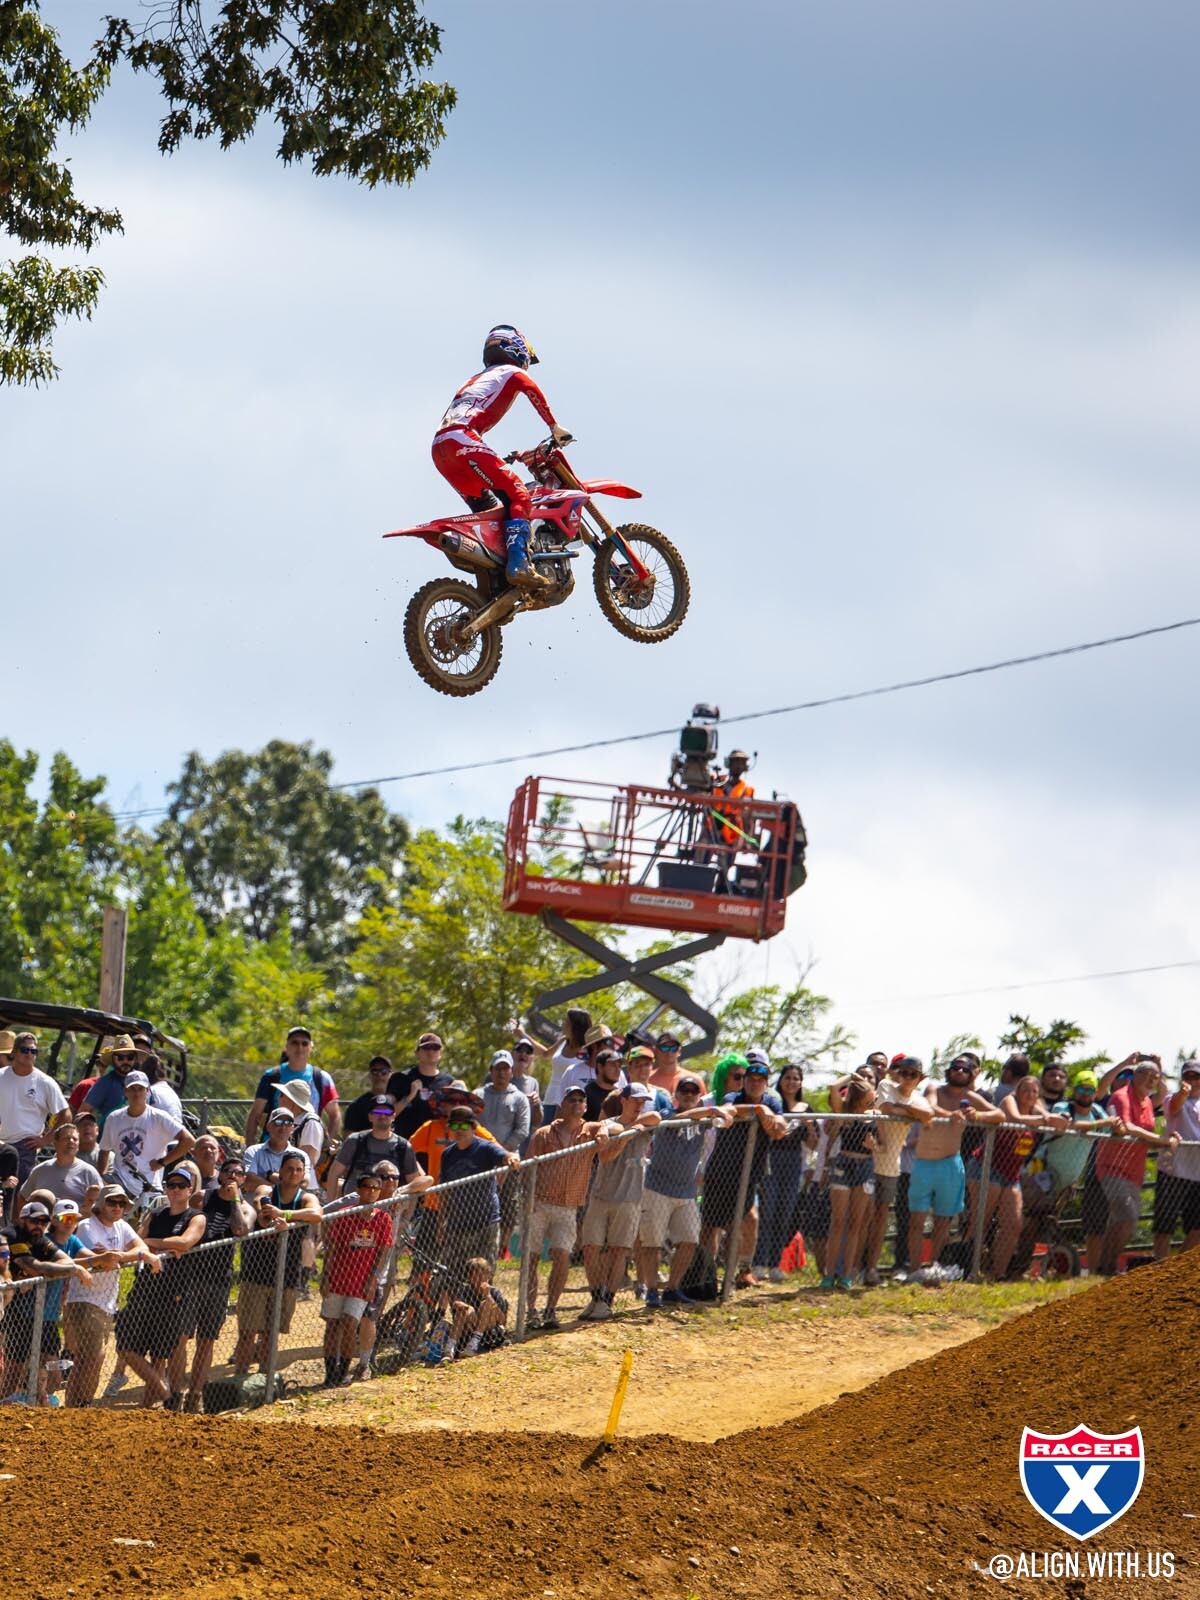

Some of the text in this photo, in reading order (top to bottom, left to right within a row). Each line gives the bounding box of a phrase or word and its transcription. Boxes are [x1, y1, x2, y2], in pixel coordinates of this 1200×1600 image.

[473, 466, 494, 487] HONDA
[452, 515, 480, 523] HONDA
[526, 881, 582, 895] SKYJACK
